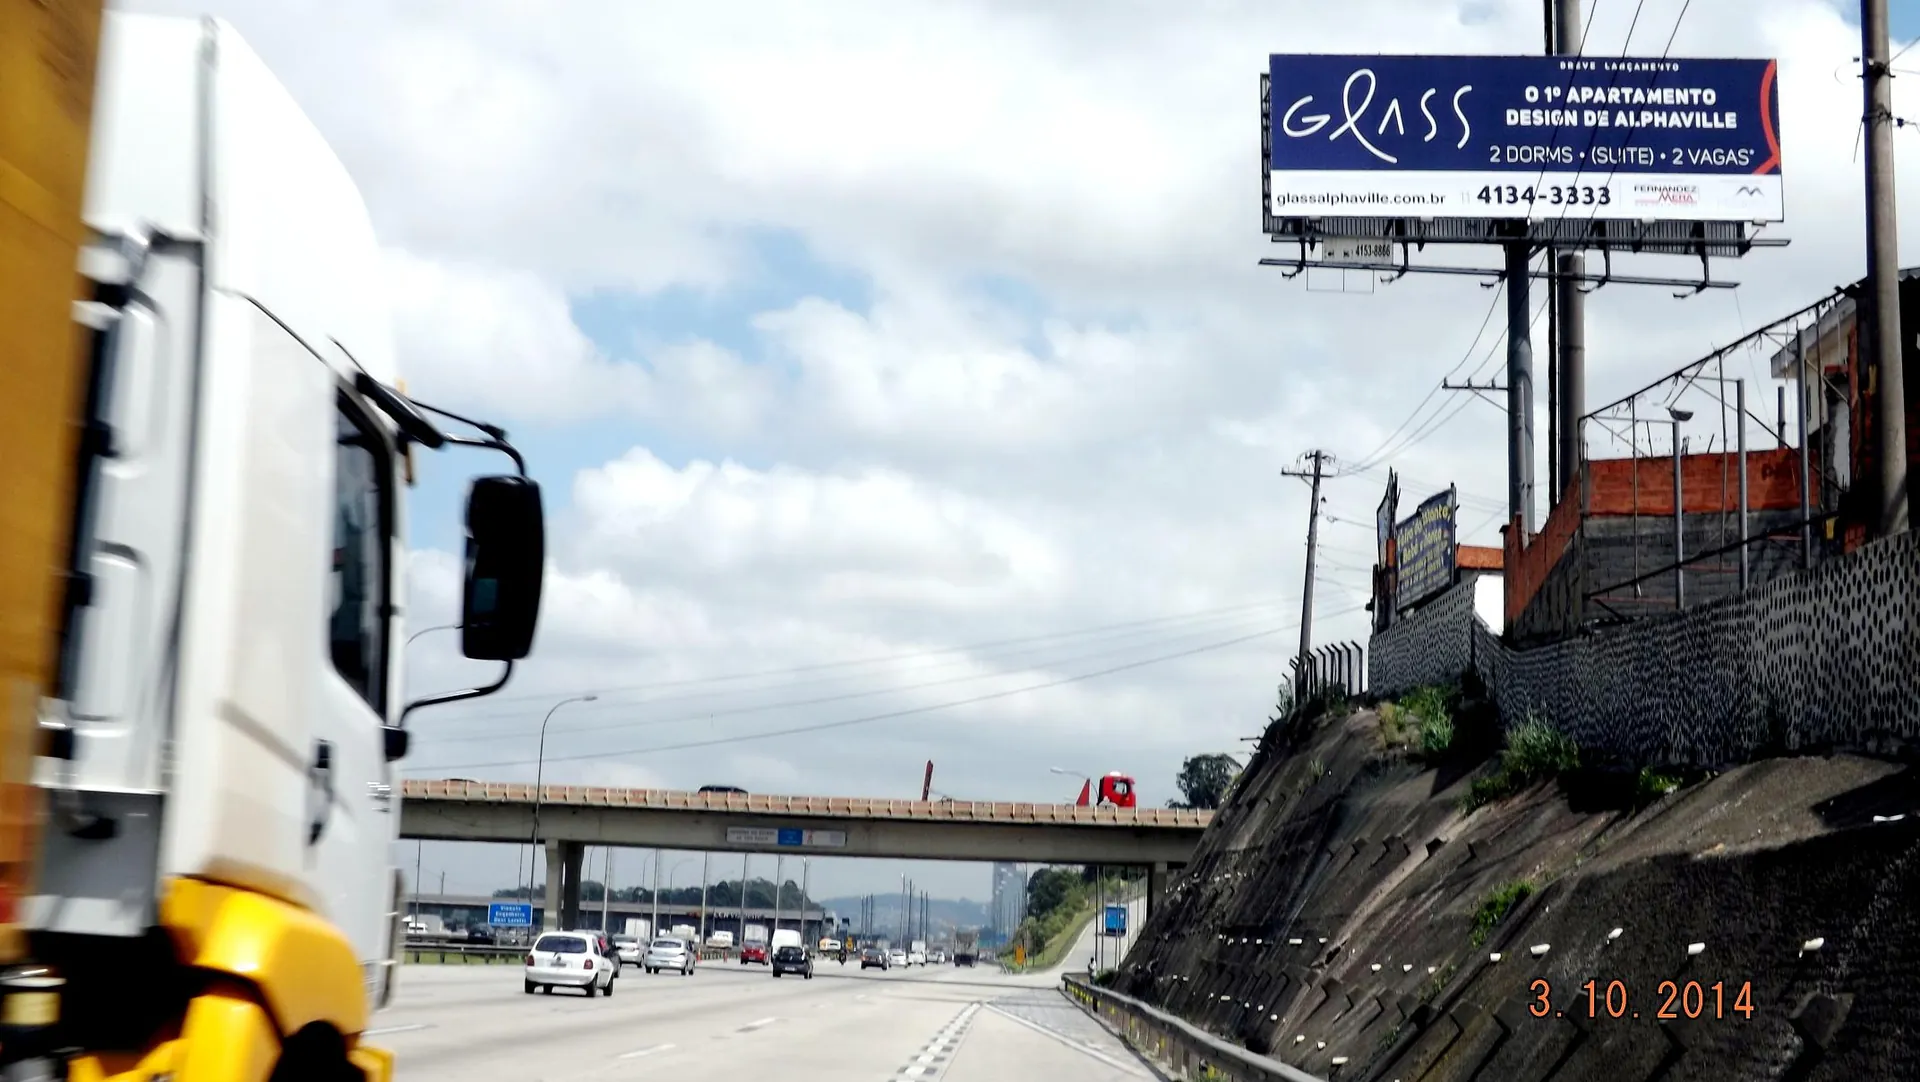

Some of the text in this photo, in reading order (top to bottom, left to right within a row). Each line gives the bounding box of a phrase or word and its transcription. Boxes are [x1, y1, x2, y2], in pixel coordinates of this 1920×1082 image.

[1560, 61, 1596, 70] BREVE
[1525, 86, 1539, 103] O
[1566, 86, 1717, 105] APARTAMENTO
[1506, 109, 1738, 129] DESIGN DE ALPHAVILLE
[1489, 145, 1501, 163] 2
[1506, 146, 1573, 163] DORMS
[1591, 146, 1654, 166] (SUITE)
[1672, 148, 1684, 165] 2
[1276, 191, 1447, 207] glassalphaville.com.br
[1477, 185, 1612, 205] 4134-3333
